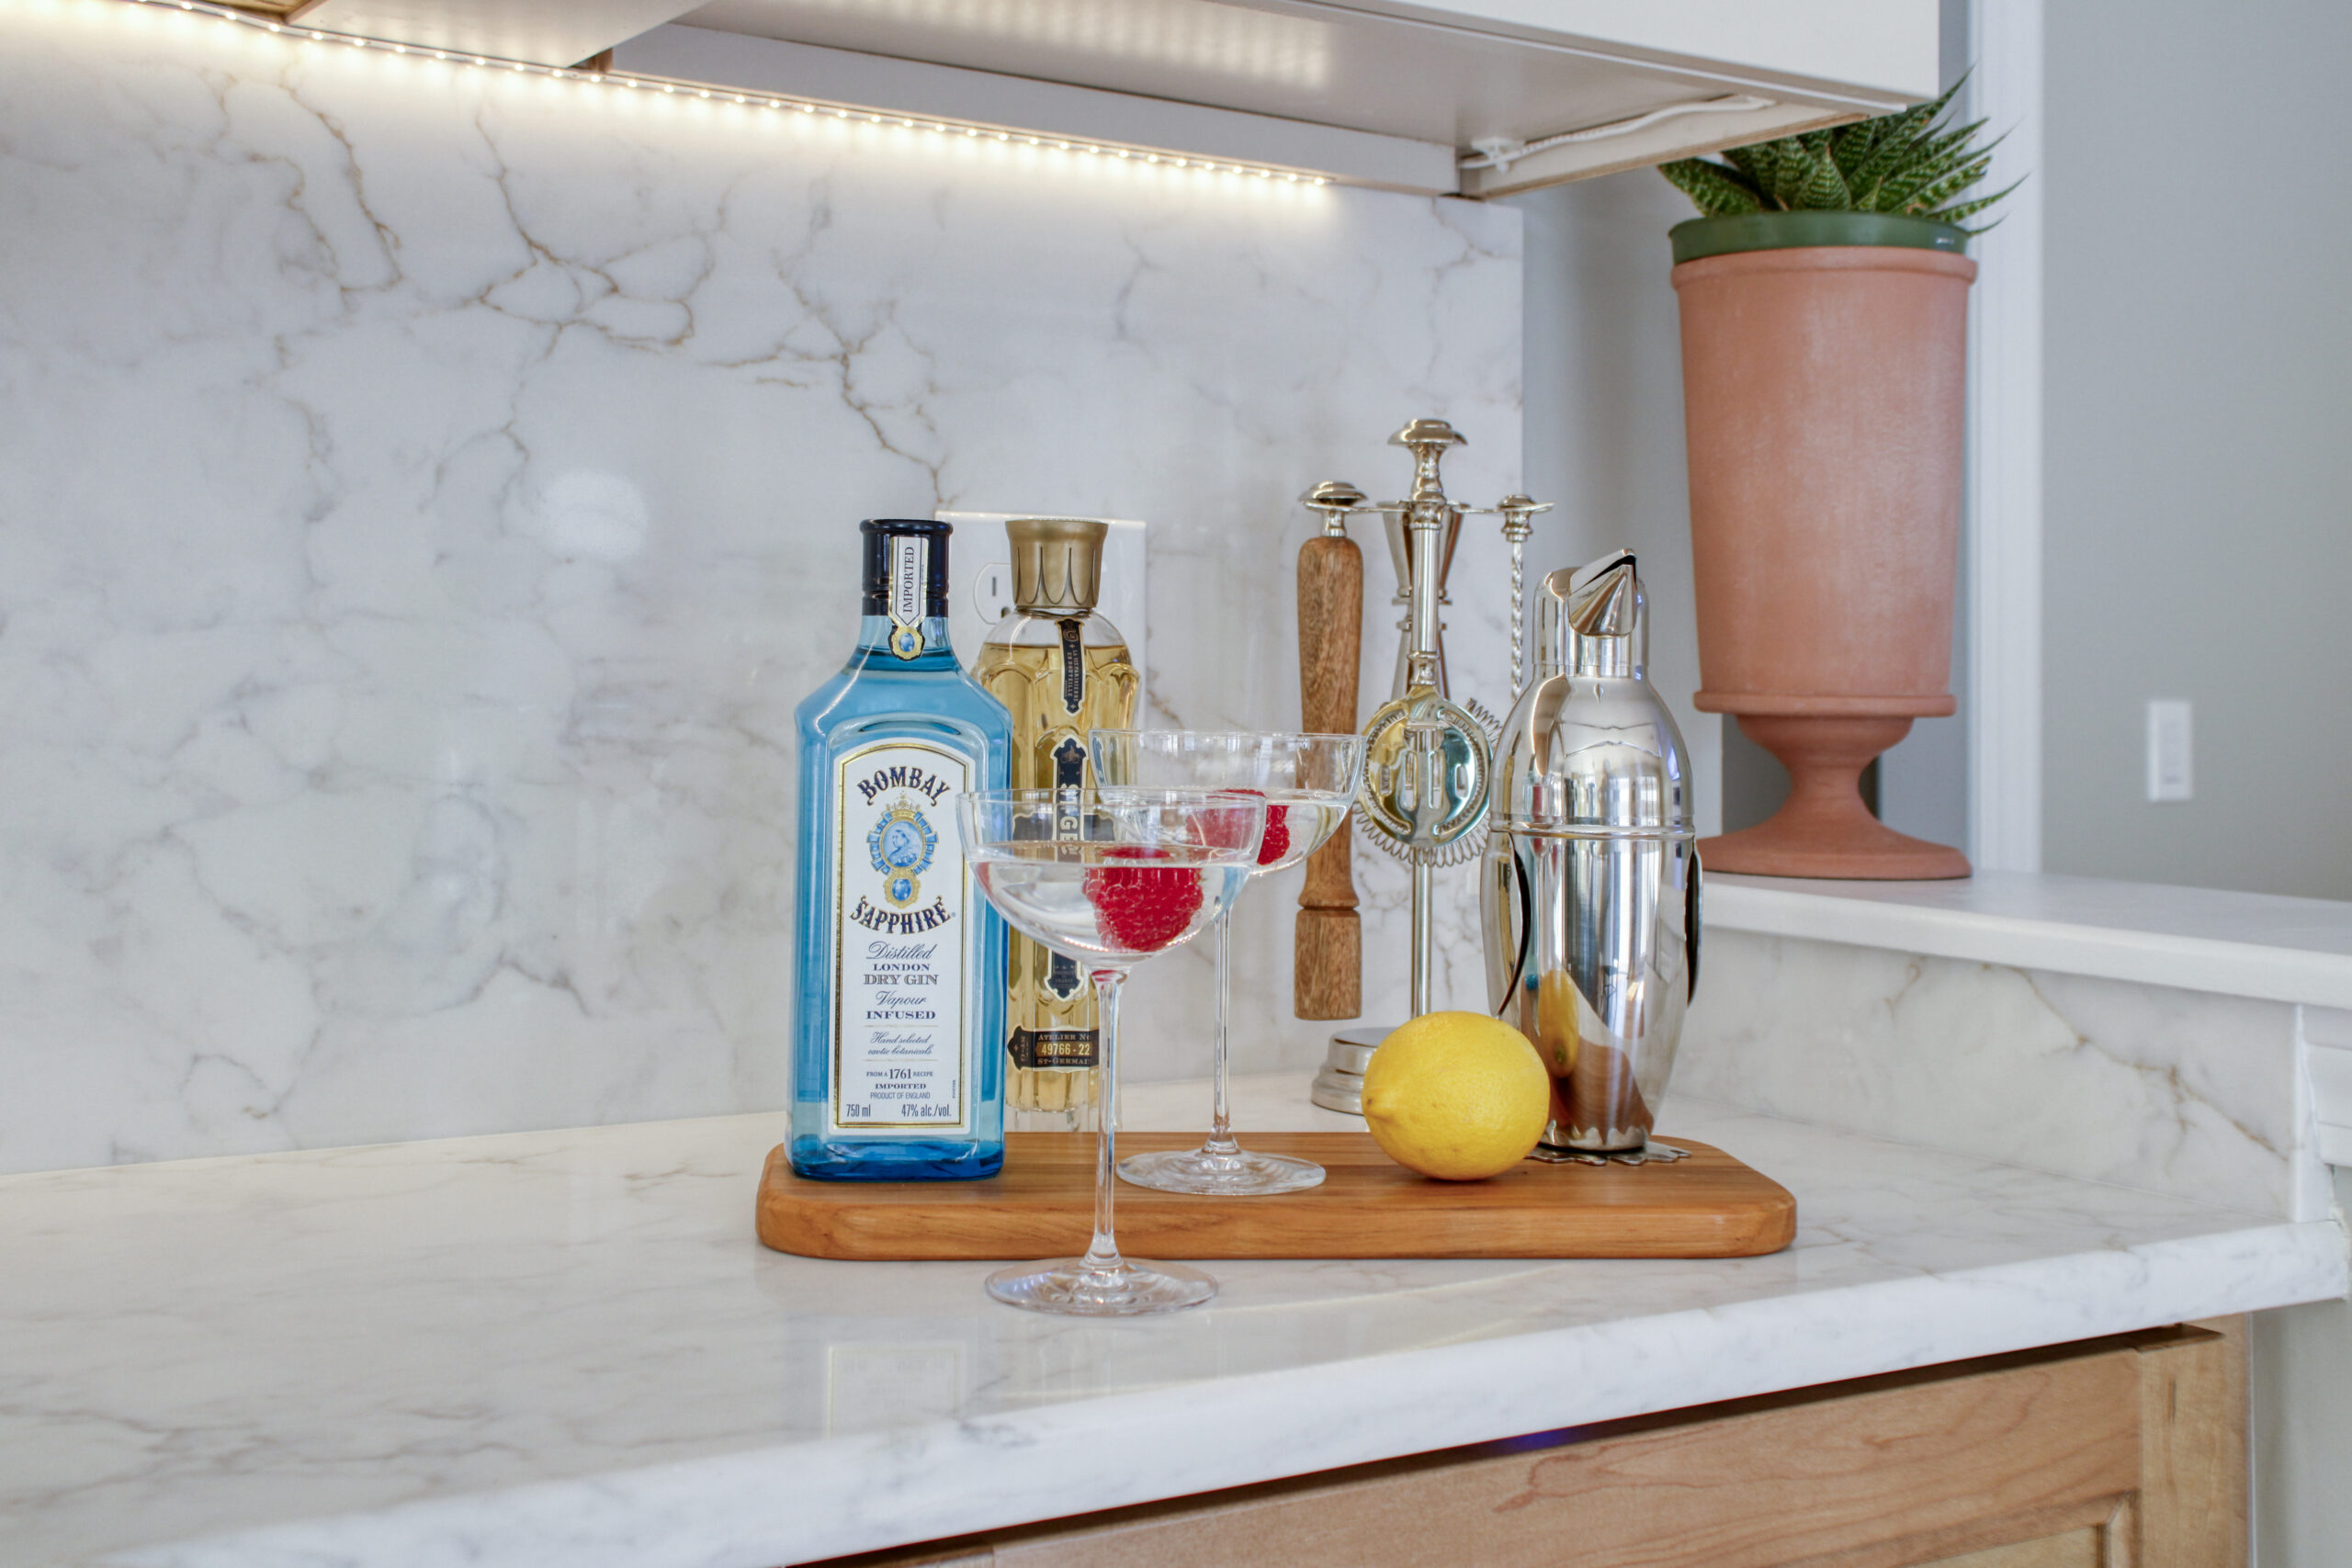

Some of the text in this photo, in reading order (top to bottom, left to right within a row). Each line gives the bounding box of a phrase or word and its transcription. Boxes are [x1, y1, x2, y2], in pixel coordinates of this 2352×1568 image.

[903, 547, 915, 613] IMPORTED
[856, 765, 951, 807] BOMBAY
[850, 895, 951, 935] SAPPHIRE
[865, 941, 938, 960] Distilled
[863, 974, 940, 986] DRY GIN
[875, 990, 927, 1010] Vapour
[866, 1010, 936, 1020] INFUSED
[870, 1032, 931, 1043] Hand selected
[867, 1045, 933, 1055] exotic botanicals
[888, 1068, 912, 1079] 1761
[870, 1091, 931, 1100] PRODUCT OF ENGLAND
[846, 1104, 871, 1118] 750 ml
[900, 1103, 952, 1118] 47% alc./vol.
